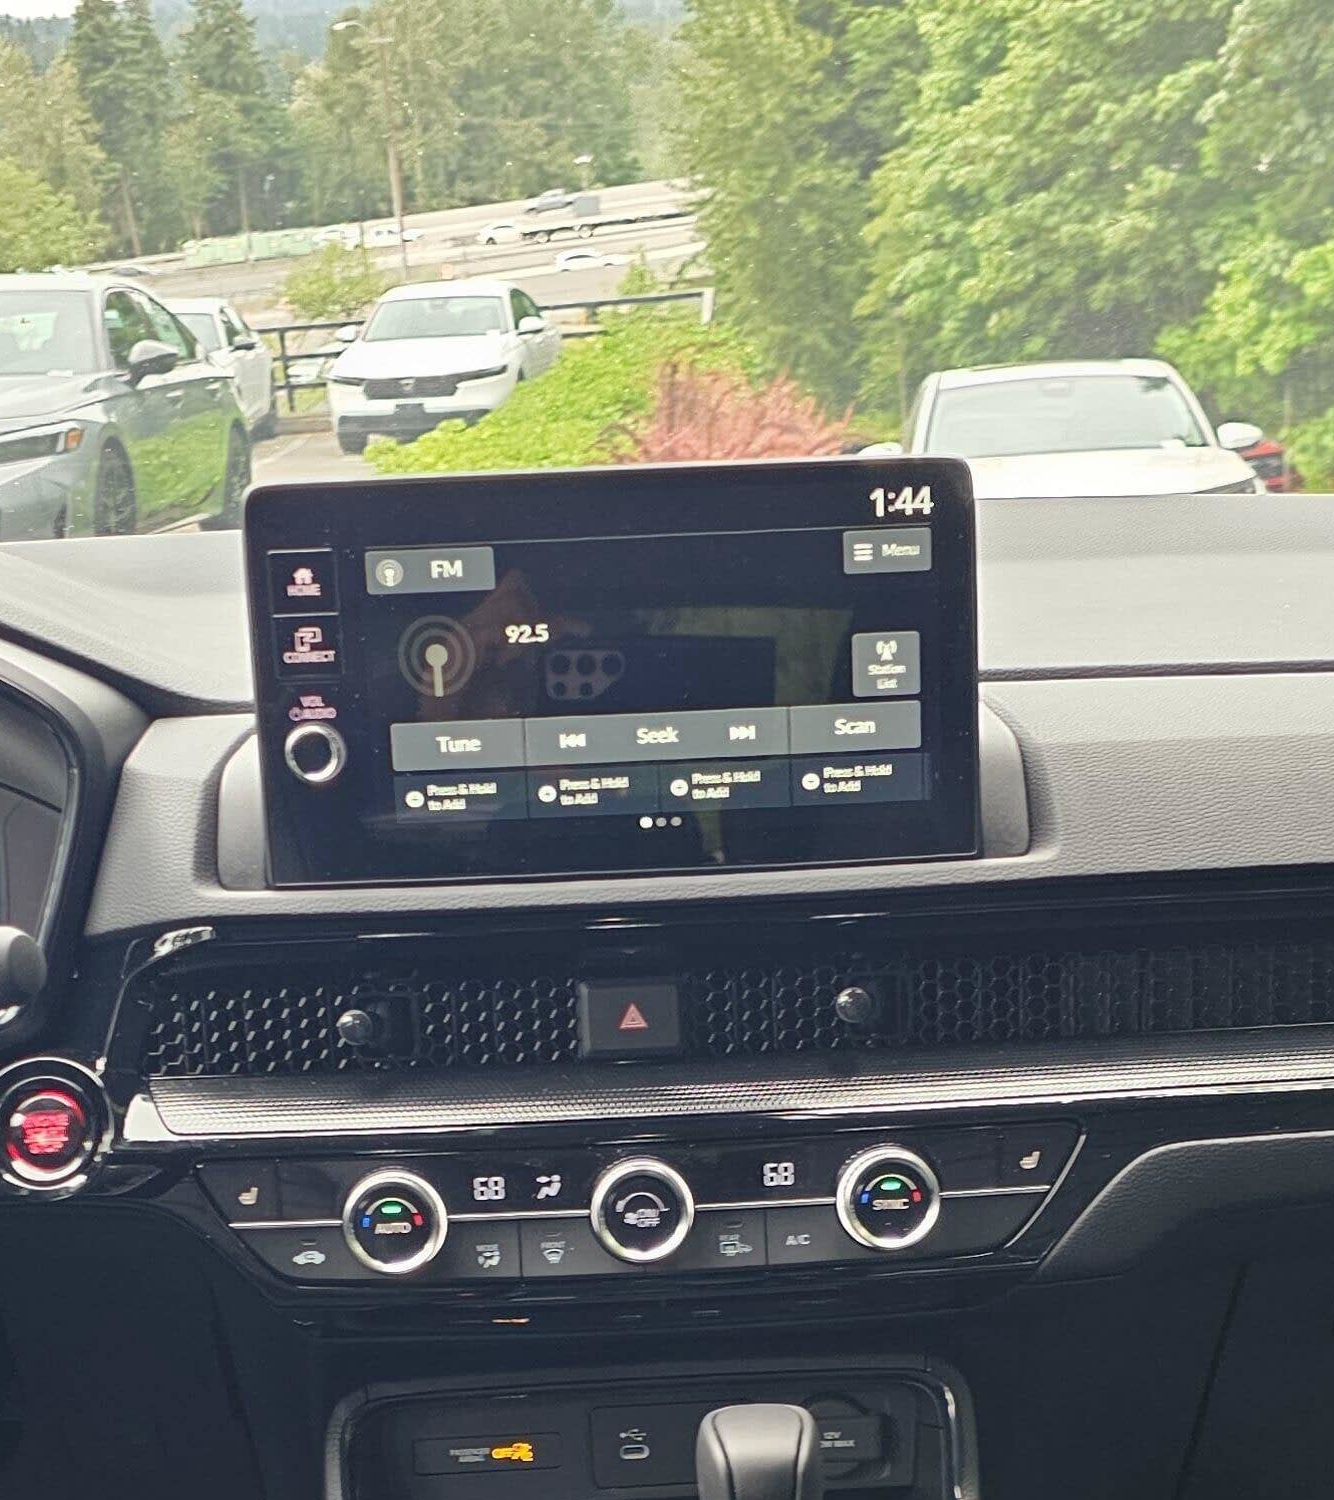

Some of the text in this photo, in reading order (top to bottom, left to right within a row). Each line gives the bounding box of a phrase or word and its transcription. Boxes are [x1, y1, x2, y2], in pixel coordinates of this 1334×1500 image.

[869, 485, 935, 518] 1:44
[881, 543, 921, 557] Menu
[430, 559, 464, 579] FM
[505, 622, 550, 644] 92.5
[636, 726, 679, 744] Seek
[834, 718, 876, 735] Scan
[435, 735, 483, 753] Tune
[763, 1162, 796, 1187] 68
[473, 1176, 506, 1201] 68
